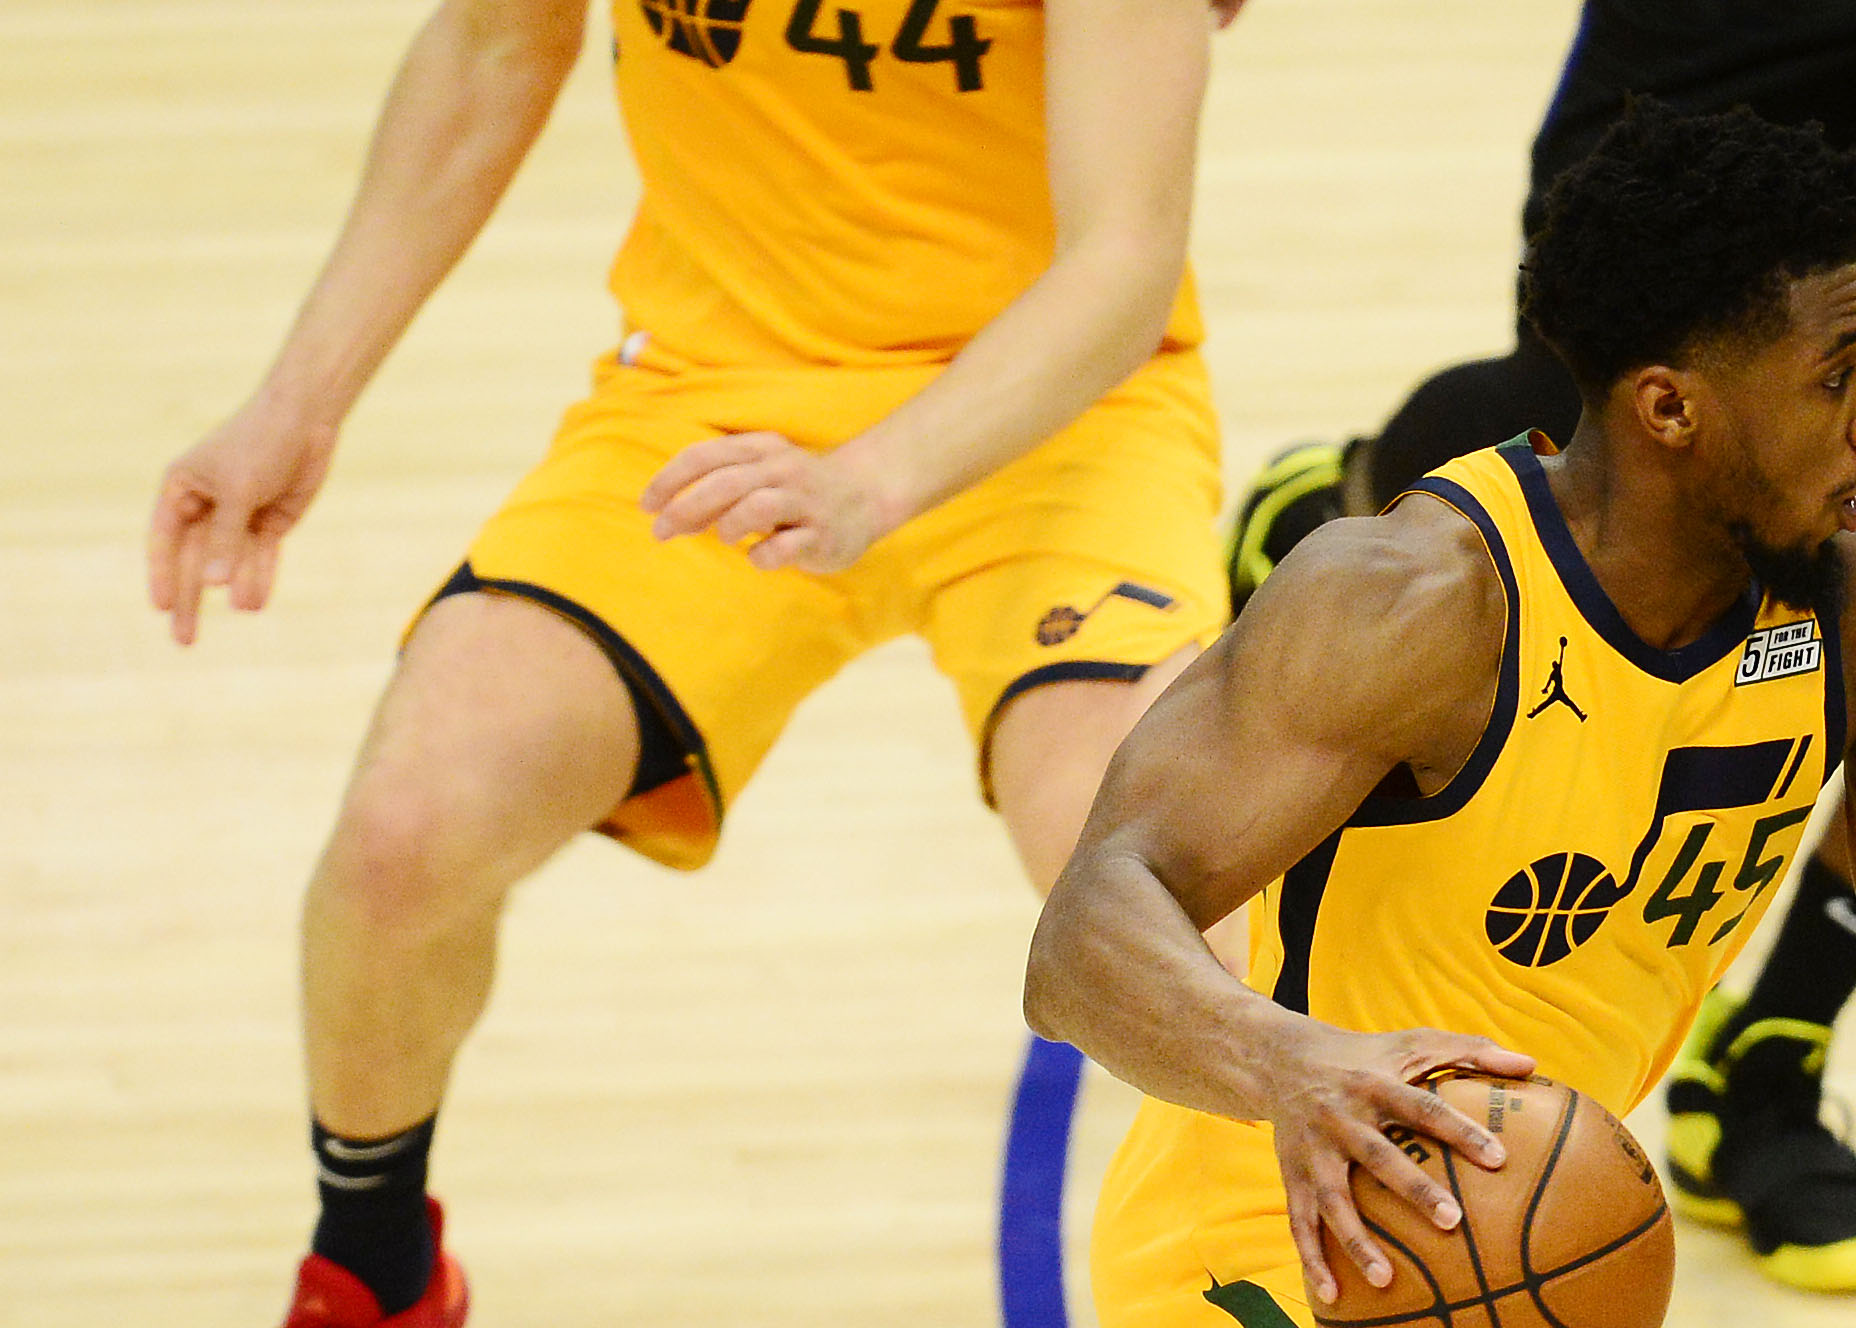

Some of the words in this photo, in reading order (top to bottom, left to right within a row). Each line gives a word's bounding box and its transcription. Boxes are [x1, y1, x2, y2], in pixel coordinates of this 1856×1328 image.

[784, 0, 993, 92] 44
[1773, 631, 1789, 644] FOR
[1791, 626, 1808, 641] THE
[1742, 636, 1763, 678] 5
[1768, 646, 1815, 673] FIGHT
[1642, 803, 1816, 949] 45
